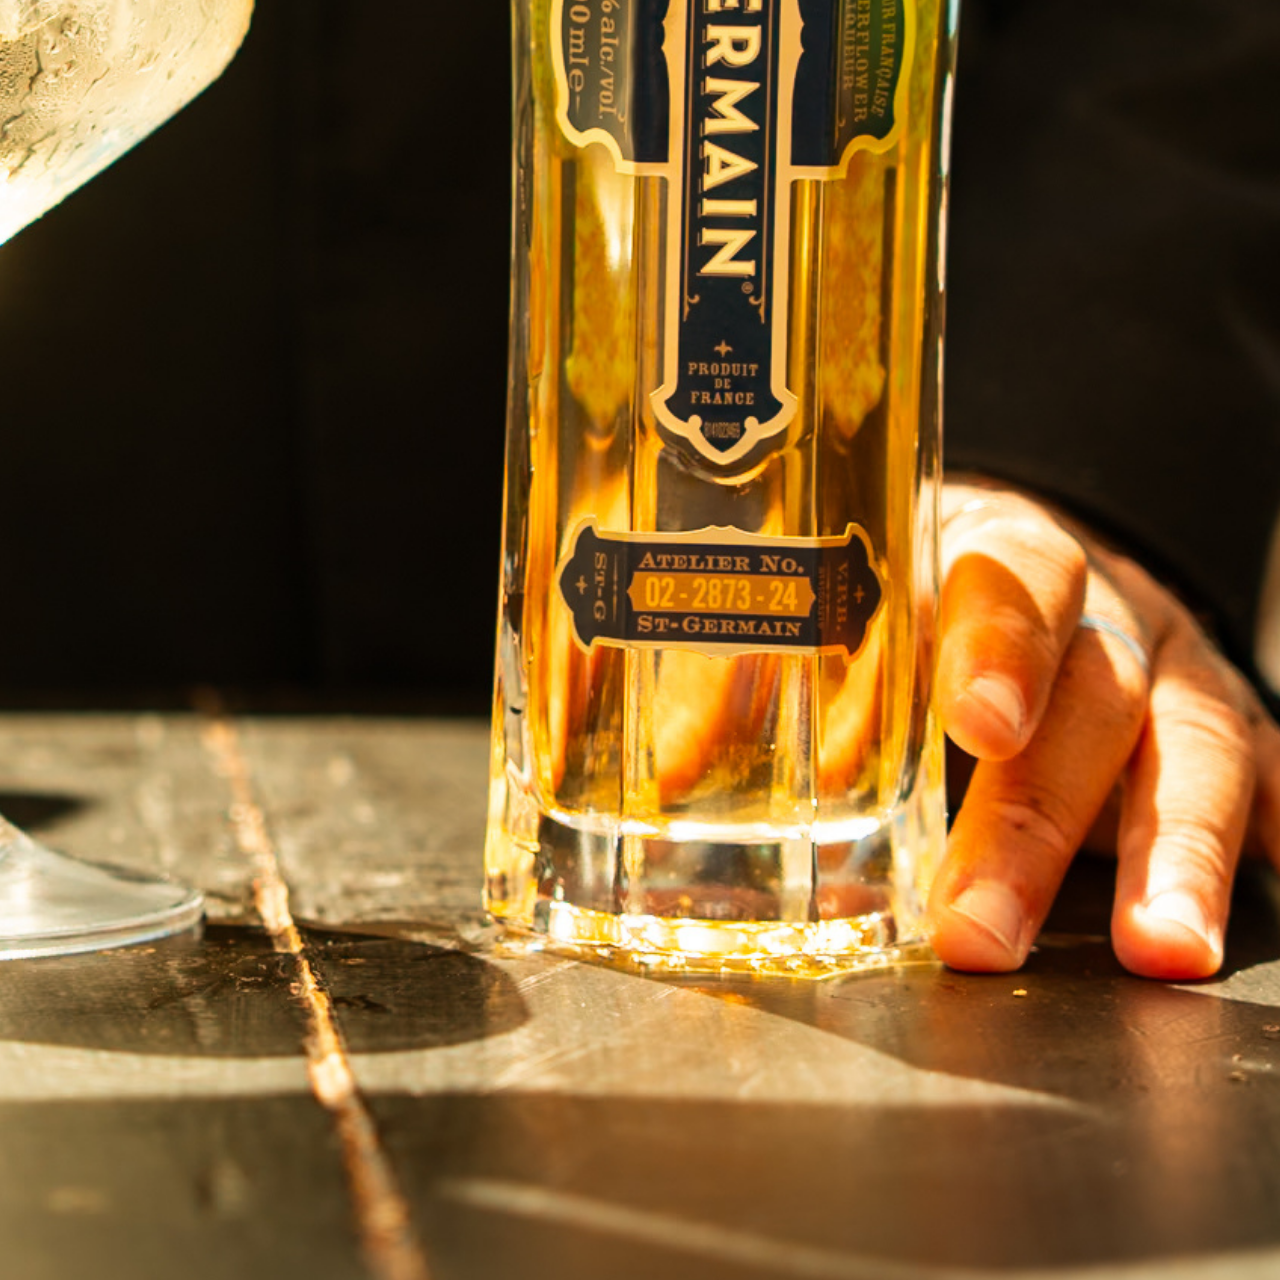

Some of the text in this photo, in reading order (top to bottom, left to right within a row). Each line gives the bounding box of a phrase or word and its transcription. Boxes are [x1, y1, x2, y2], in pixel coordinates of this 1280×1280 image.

[687, 361, 759, 377] PRODUIT
[714, 378, 732, 389] DE
[690, 391, 755, 405] FRANCE
[638, 551, 751, 571] ATELIER
[636, 614, 802, 637] ST-GERMAIN
